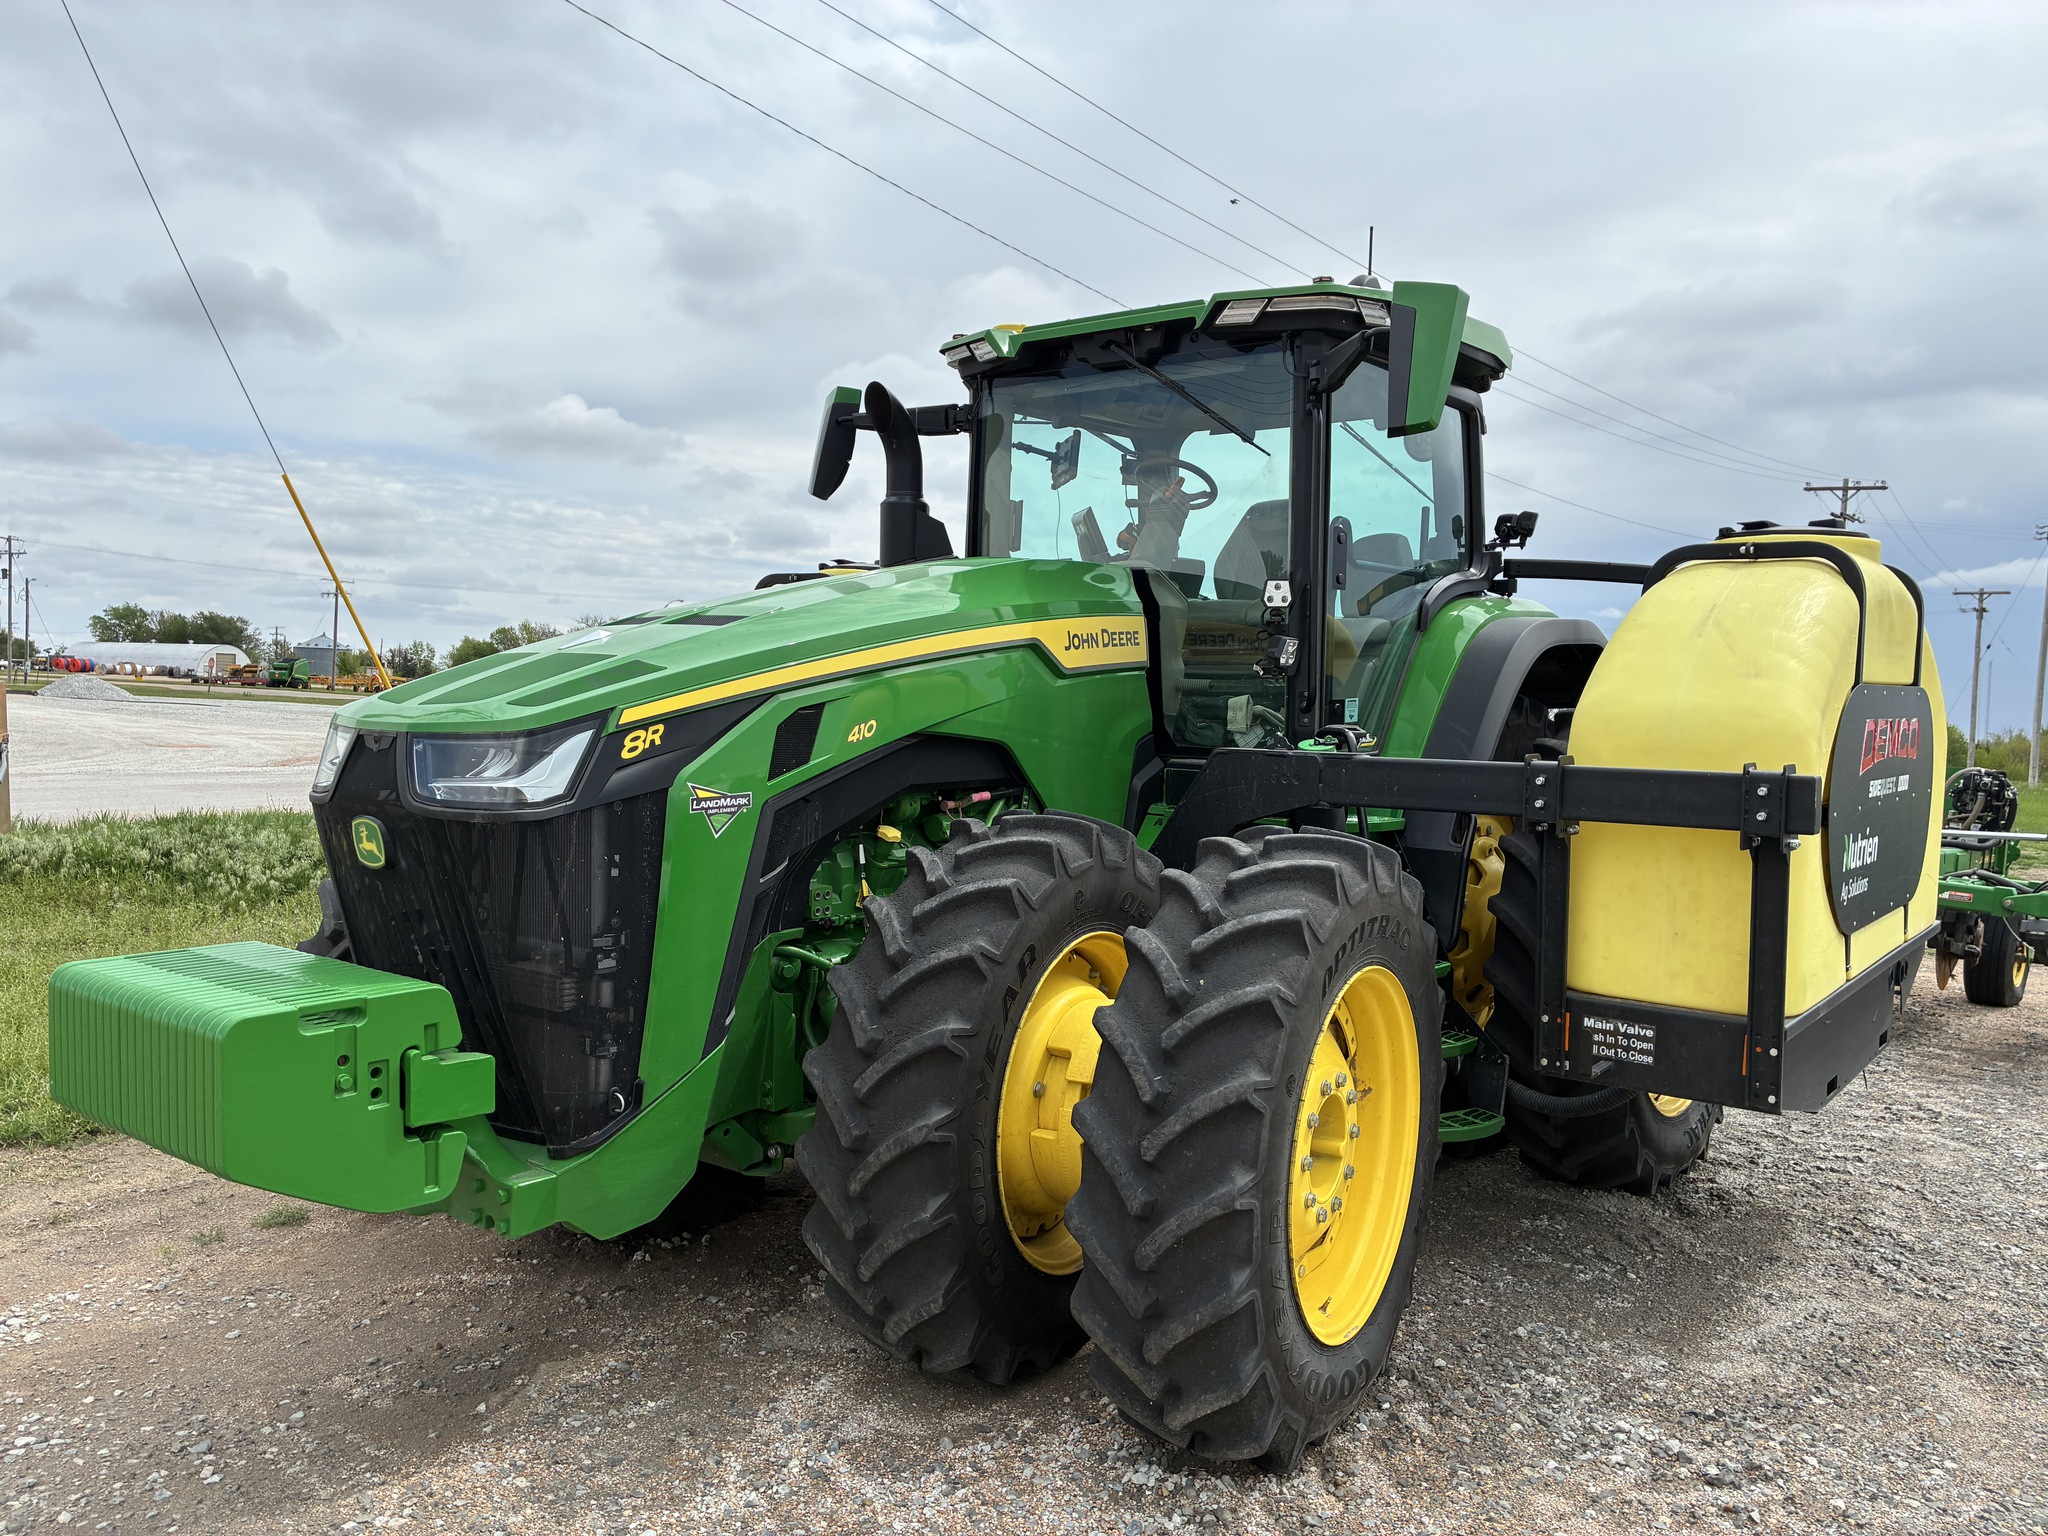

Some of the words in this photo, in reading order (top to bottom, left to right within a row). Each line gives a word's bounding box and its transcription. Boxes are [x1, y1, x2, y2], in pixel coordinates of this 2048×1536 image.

[1065, 630, 1099, 651] JOHN
[1101, 628, 1140, 648] DEERE
[620, 723, 665, 760] 8R
[847, 719, 877, 744] 410
[1860, 718, 1920, 776] DEMCO
[707, 806, 738, 814] IMPLEMENT
[1842, 826, 1879, 873] Nutrien
[1840, 881, 1849, 906] Ag
[1848, 876, 1869, 899] Solutions
[1321, 914, 1411, 1001] OPTITRAC
[1583, 1017, 1614, 1031] Main
[1618, 1023, 1655, 1037] Valve
[1593, 1032, 1604, 1042] sh
[1606, 1033, 1615, 1044] In
[1617, 1036, 1628, 1046] To
[1630, 1038, 1654, 1051] Open
[1600, 1046, 1615, 1057] Out
[1617, 1048, 1627, 1059] To
[1629, 1051, 1654, 1064] Close
